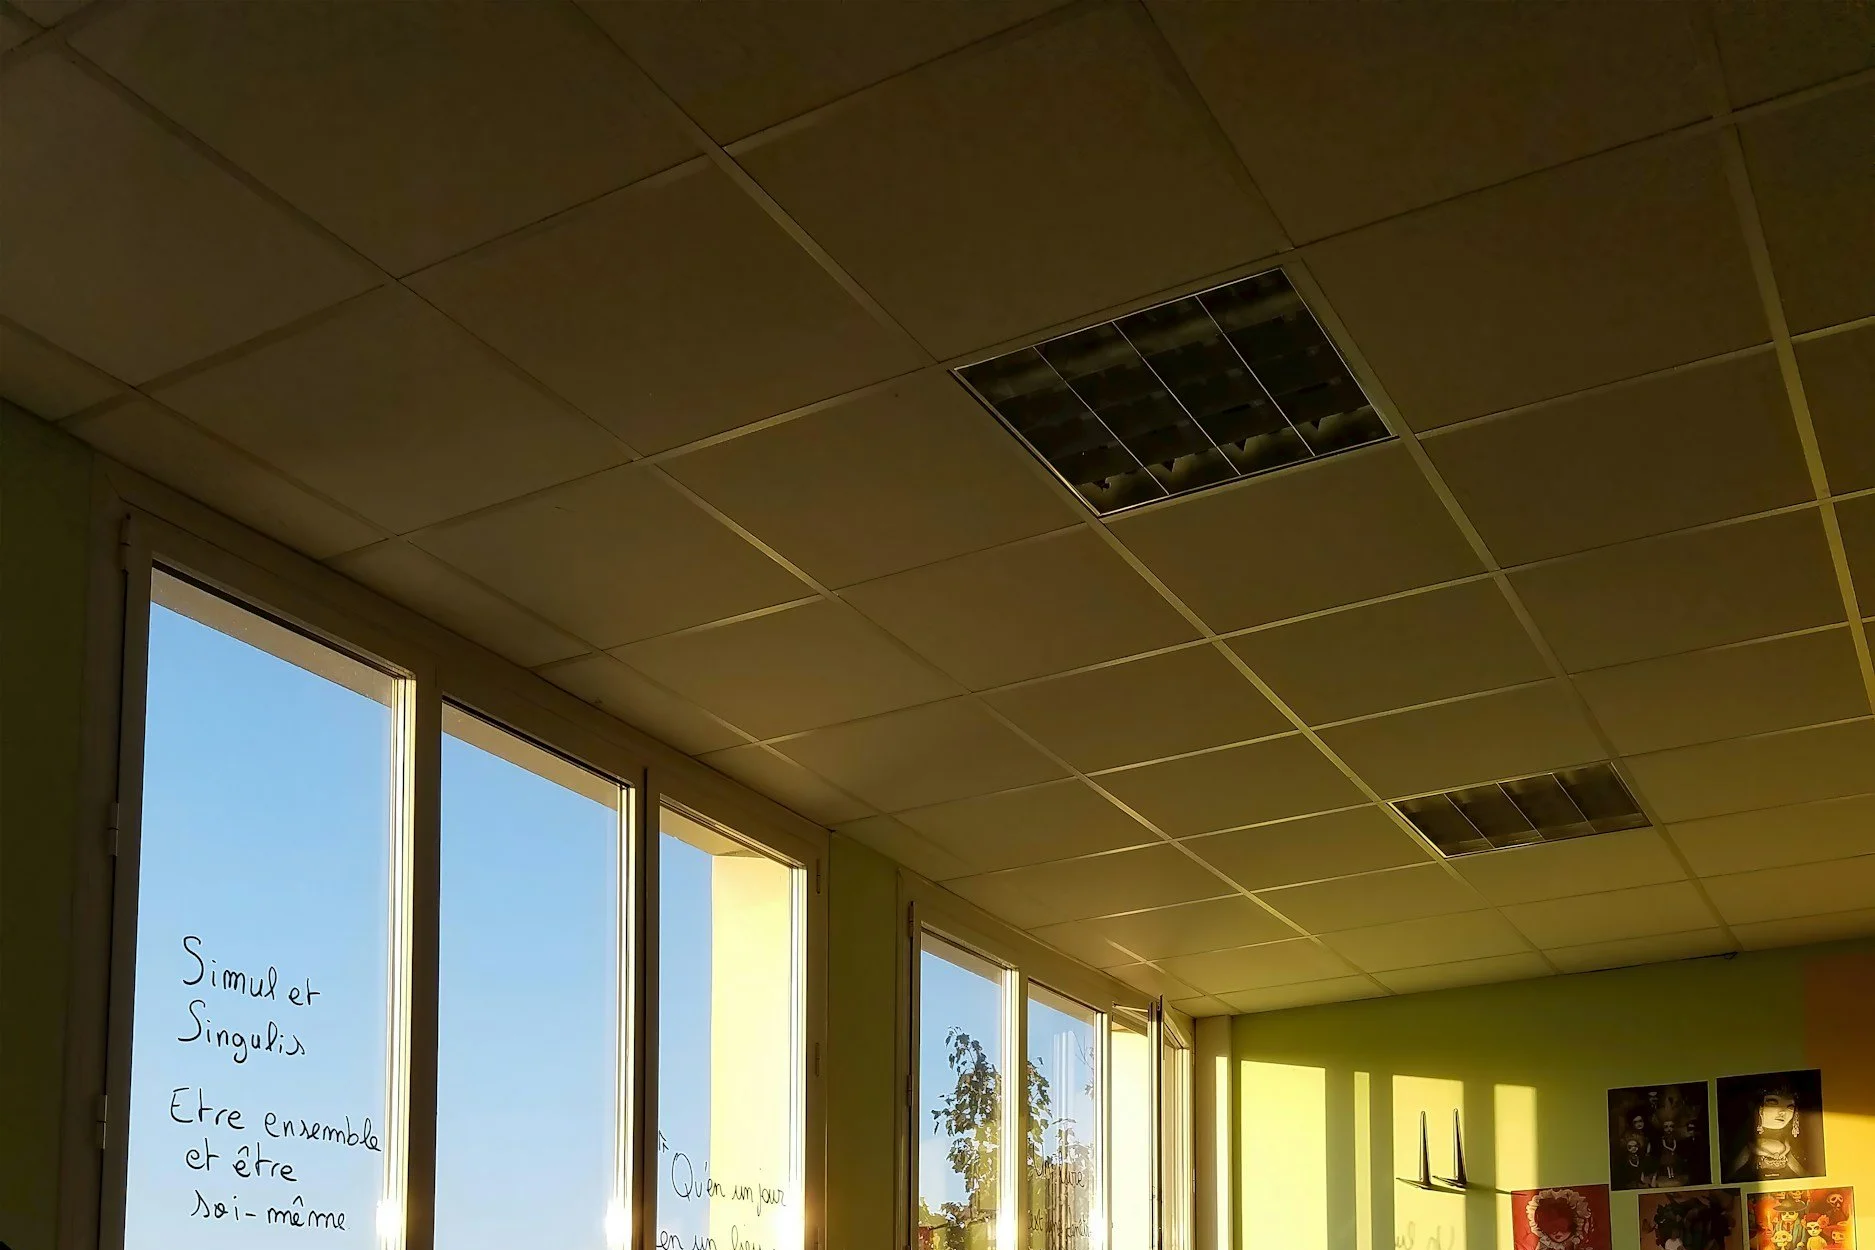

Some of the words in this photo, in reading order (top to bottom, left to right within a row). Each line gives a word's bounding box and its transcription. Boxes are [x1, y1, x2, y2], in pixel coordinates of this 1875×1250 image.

[183, 936, 277, 1001] Simul
[288, 978, 320, 1006] et
[178, 1000, 305, 1063] Singulis
[170, 1087, 245, 1130] Etre
[264, 1112, 382, 1151] ensemble
[186, 1138, 220, 1171] et
[233, 1142, 297, 1181] être
[672, 1152, 725, 1201] Qu'en
[732, 1184, 753, 1202] un
[757, 1168, 786, 1216] jour
[191, 1189, 347, 1231] soi-même
[656, 1230, 684, 1250] en
